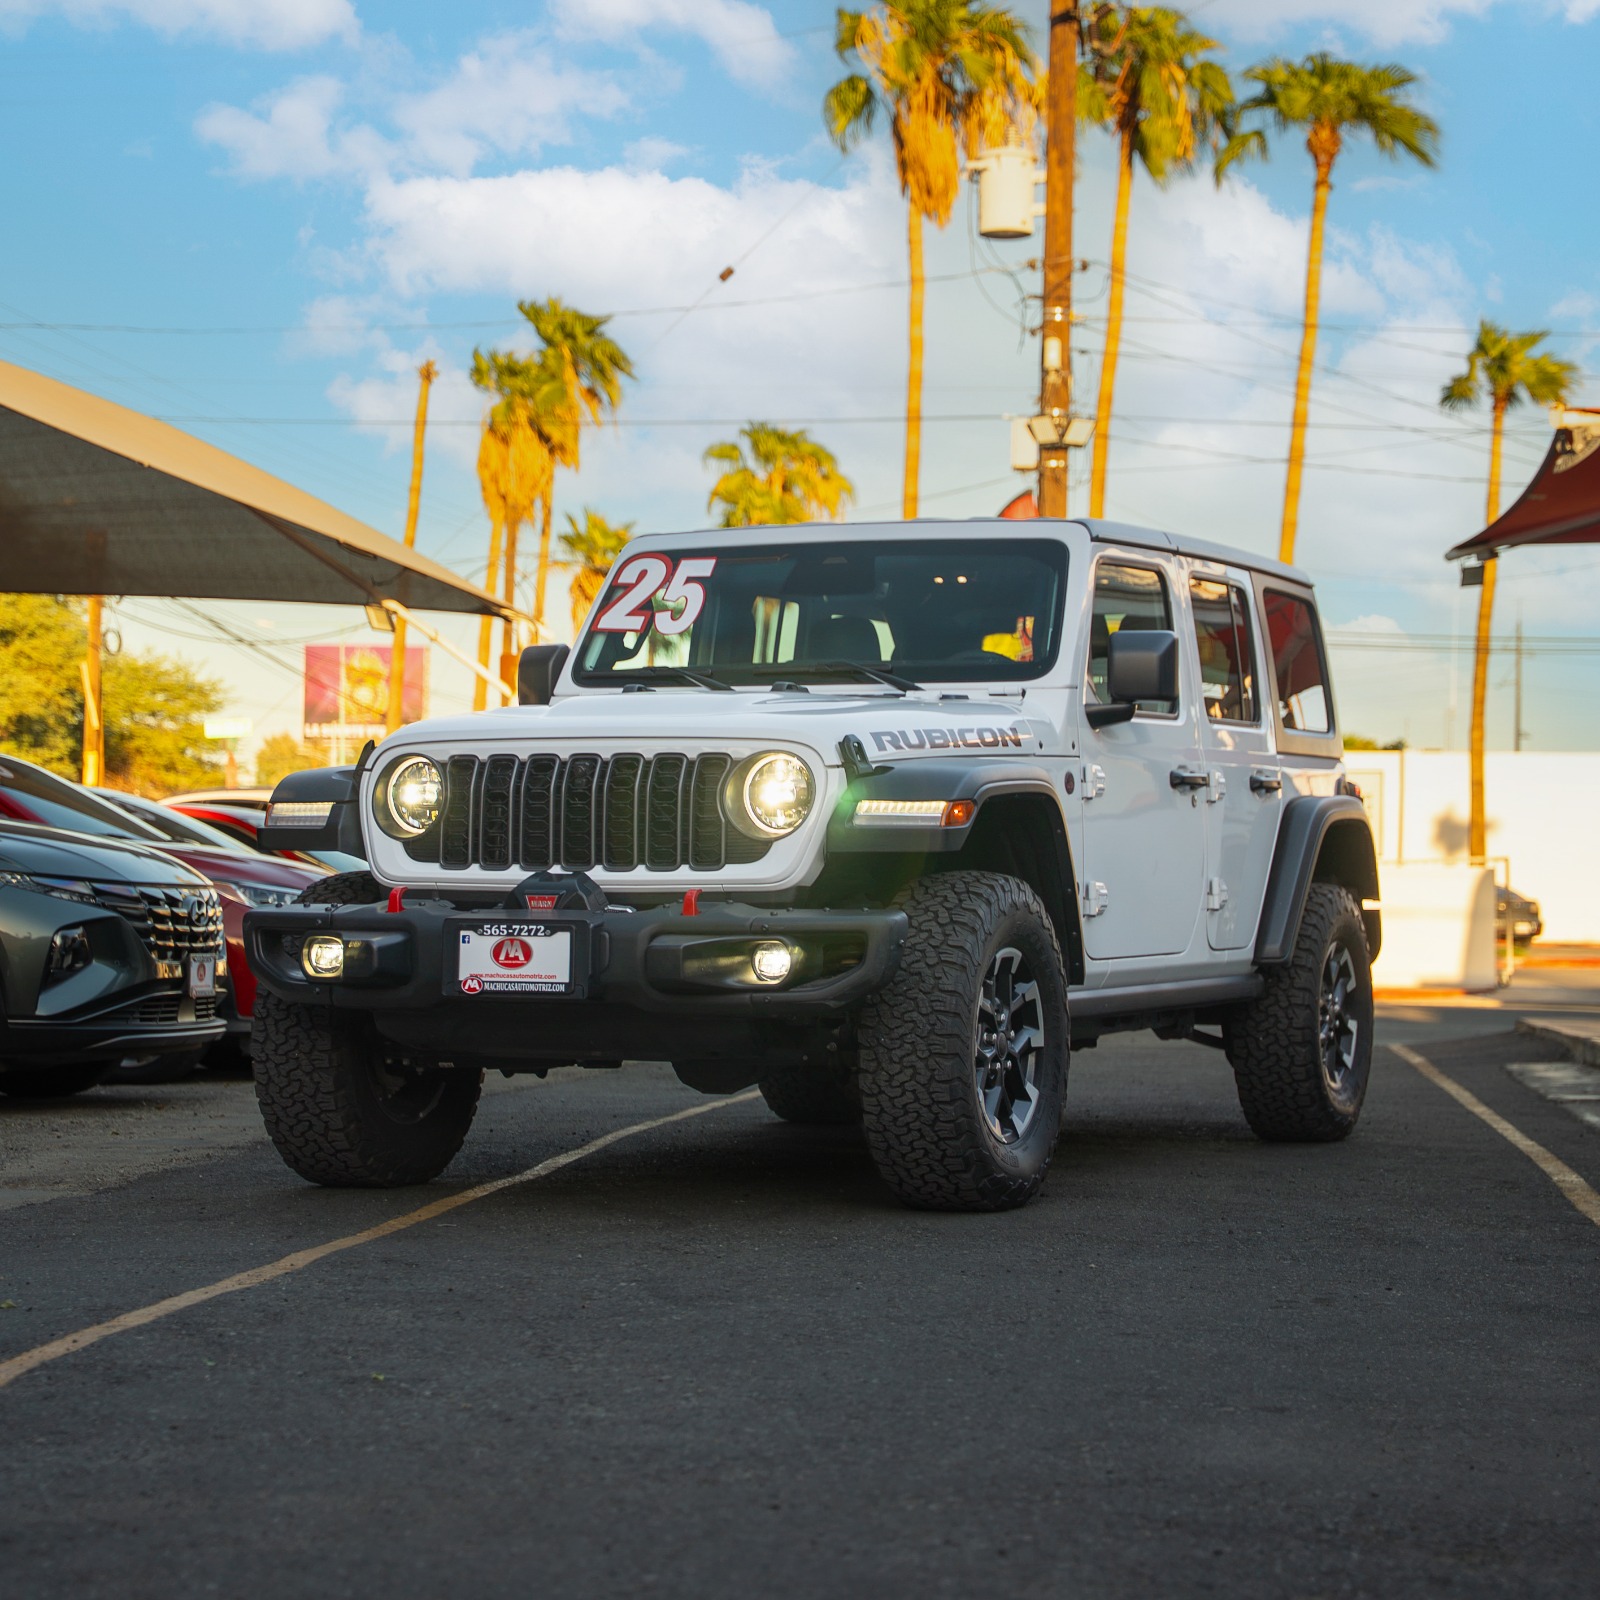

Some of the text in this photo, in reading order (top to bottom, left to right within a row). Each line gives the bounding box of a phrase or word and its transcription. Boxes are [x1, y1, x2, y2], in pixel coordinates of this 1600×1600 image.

[591, 551, 718, 635] 25
[869, 727, 1022, 751] RUBICON
[531, 900, 553, 908] WARN
[483, 924, 545, 936] 565-7272
[484, 982, 565, 992] MACHUCASAUTOMOTRIZ.COM
